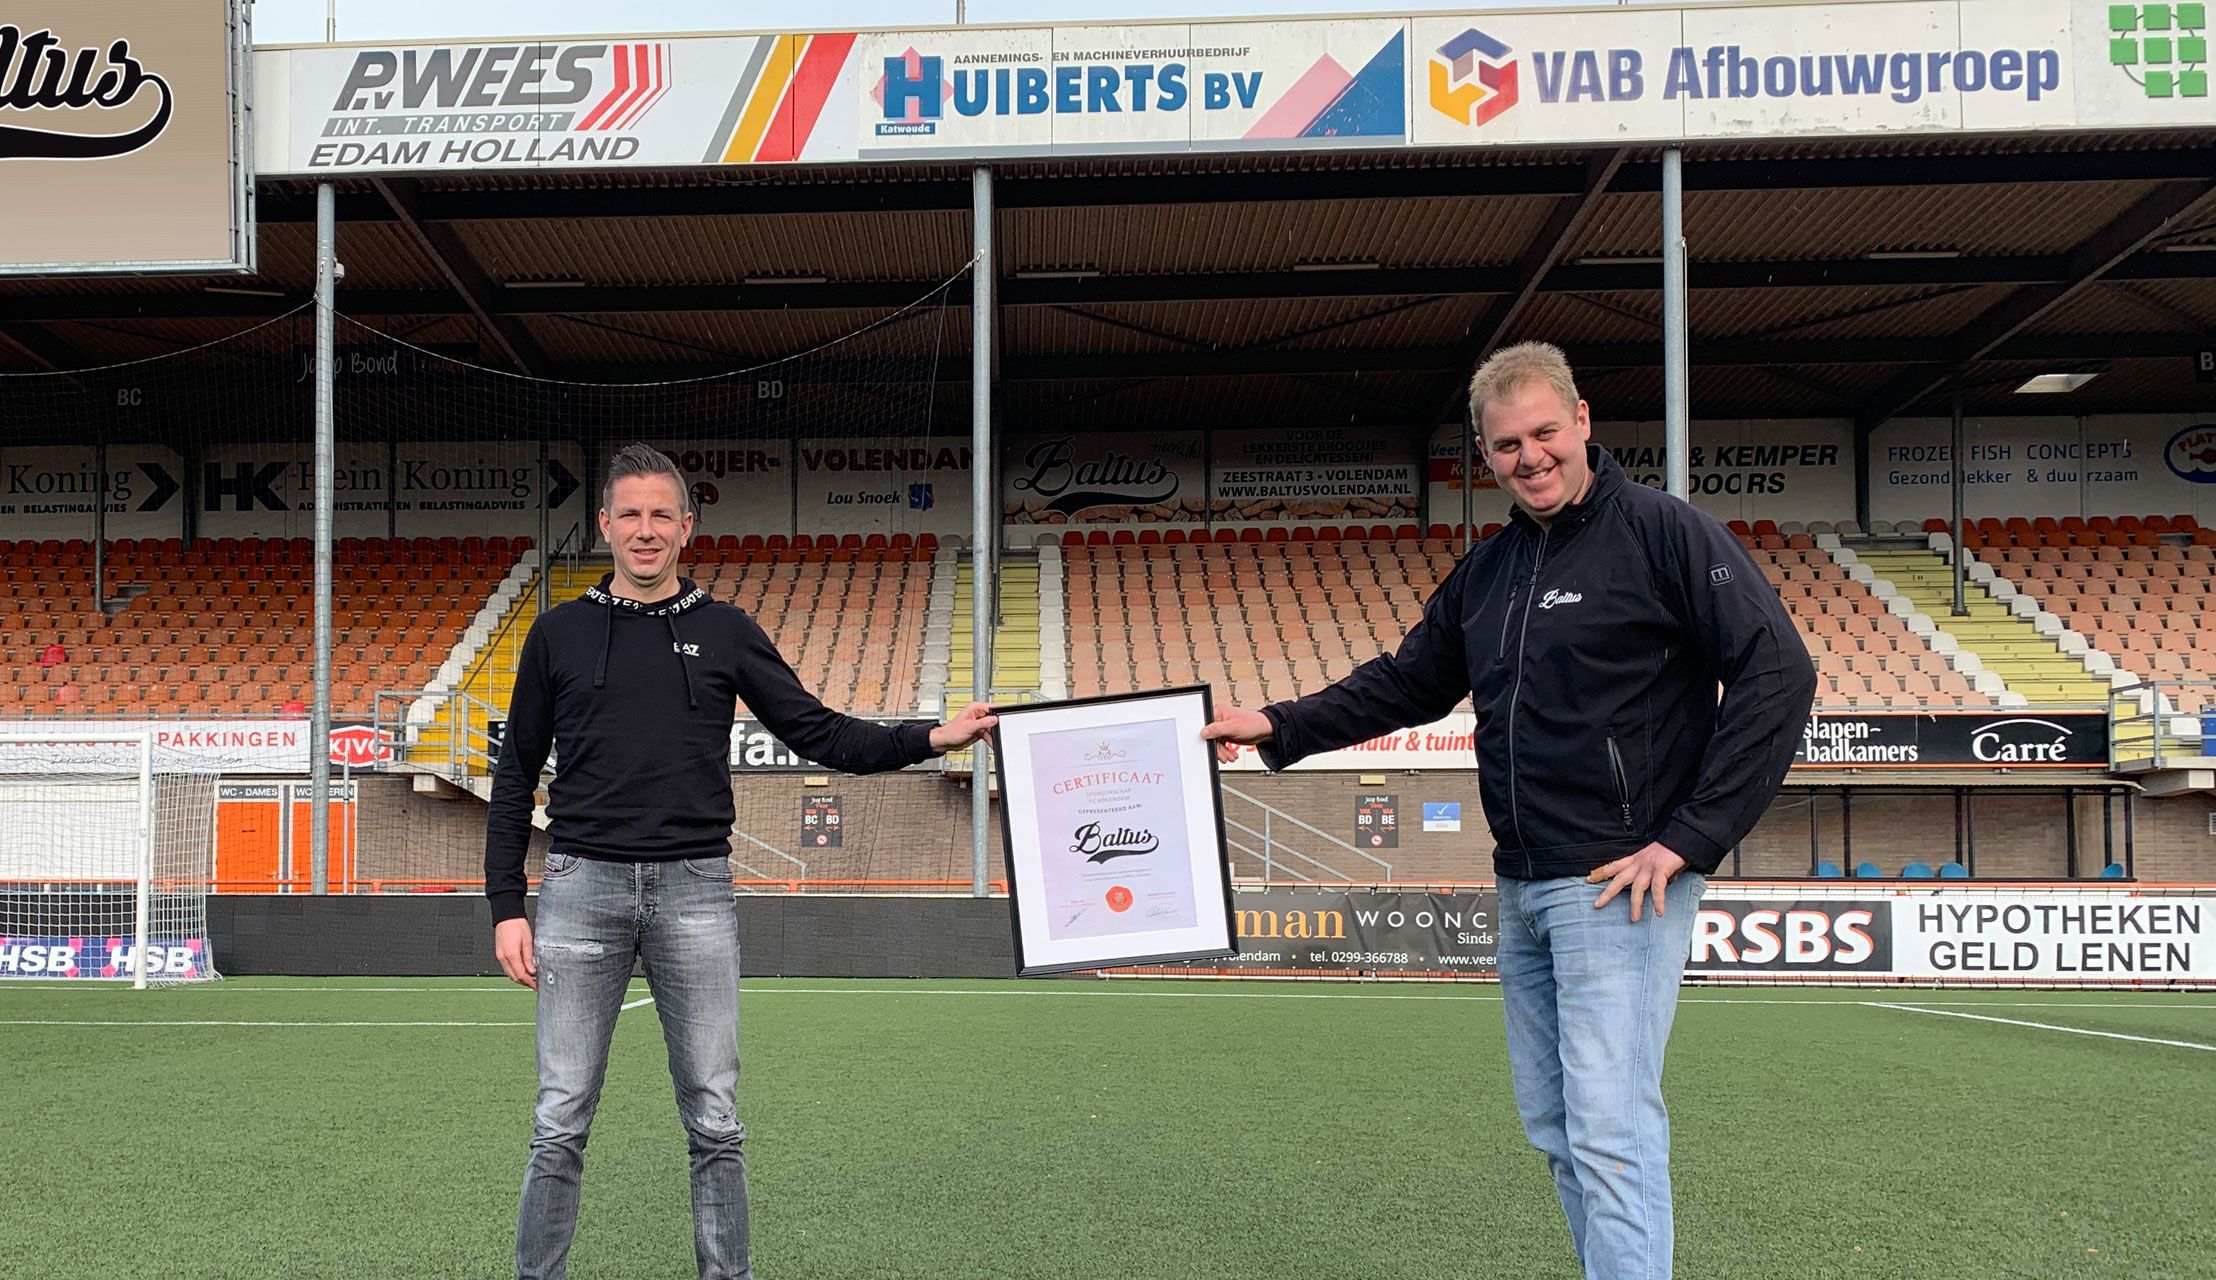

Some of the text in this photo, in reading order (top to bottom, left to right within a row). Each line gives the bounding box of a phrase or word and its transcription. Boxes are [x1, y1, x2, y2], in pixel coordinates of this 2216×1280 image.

[953, 46, 1251, 65] AANNEMINGS- EN MACHINEVERHUURBEDRIJF
[0, 24, 155, 115] ltus
[403, 45, 608, 108] WEES
[1532, 43, 2060, 103] VAB Afbouwgroep
[1205, 71, 1264, 110] BV
[332, 113, 563, 135] INT. TRANSPORT
[880, 124, 931, 134] Katwoude
[308, 137, 640, 167] EDAM HOLLAND
[351, 350, 397, 375] Bond
[2201, 352, 2216, 370] B
[117, 388, 142, 406] BC
[757, 380, 784, 398] BD
[1286, 429, 1344, 441] VOOR DE
[2178, 432, 2216, 452] PLAT
[1243, 440, 1386, 453] LEKKERSTE BROODJES
[1689, 447, 1705, 467] &
[1715, 445, 1838, 466] KEMPER
[1971, 446, 2011, 460] FISH
[1014, 437, 1172, 500] Baltus
[1255, 454, 1274, 464] EN
[403, 459, 531, 498] Koning
[1223, 468, 1408, 483] ZEESTRAAT 3 VOLENDAM
[1889, 471, 1950, 484] Gezond
[1963, 470, 2012, 484] lekker
[2027, 469, 2039, 482] &
[204, 462, 290, 511] HK
[1218, 484, 1411, 497] WWW.BALTUSVOLENDAM.NL
[23, 503, 127, 513] BELASTINGAVIES
[419, 501, 525, 510] BELASTINGADVIES
[827, 491, 900, 505] Lou Snoek
[1539, 588, 1582, 609] Baltus
[1405, 731, 1420, 751] &
[1426, 731, 1475, 751] tuint
[1796, 739, 1918, 762] -badkamers
[1972, 733, 2067, 762] Carré
[220, 787, 237, 797] WC
[245, 787, 278, 797] DAMES
[296, 787, 353, 797] WC EREN
[1053, 771, 1164, 795] CERTIFICAAT
[805, 815, 839, 825] BC BD
[1358, 814, 1395, 825] BD BE
[1069, 821, 1156, 856] Baltus
[1236, 908, 1488, 939] man WOONC
[1919, 903, 2201, 935] HYPOTHEKEN
[1457, 932, 1493, 944] Sinds
[1690, 909, 1874, 964] RSBS
[1310, 952, 1328, 963] tel.
[1331, 951, 1409, 964] 0299-366788
[1929, 941, 2191, 971] GELD LENEN
